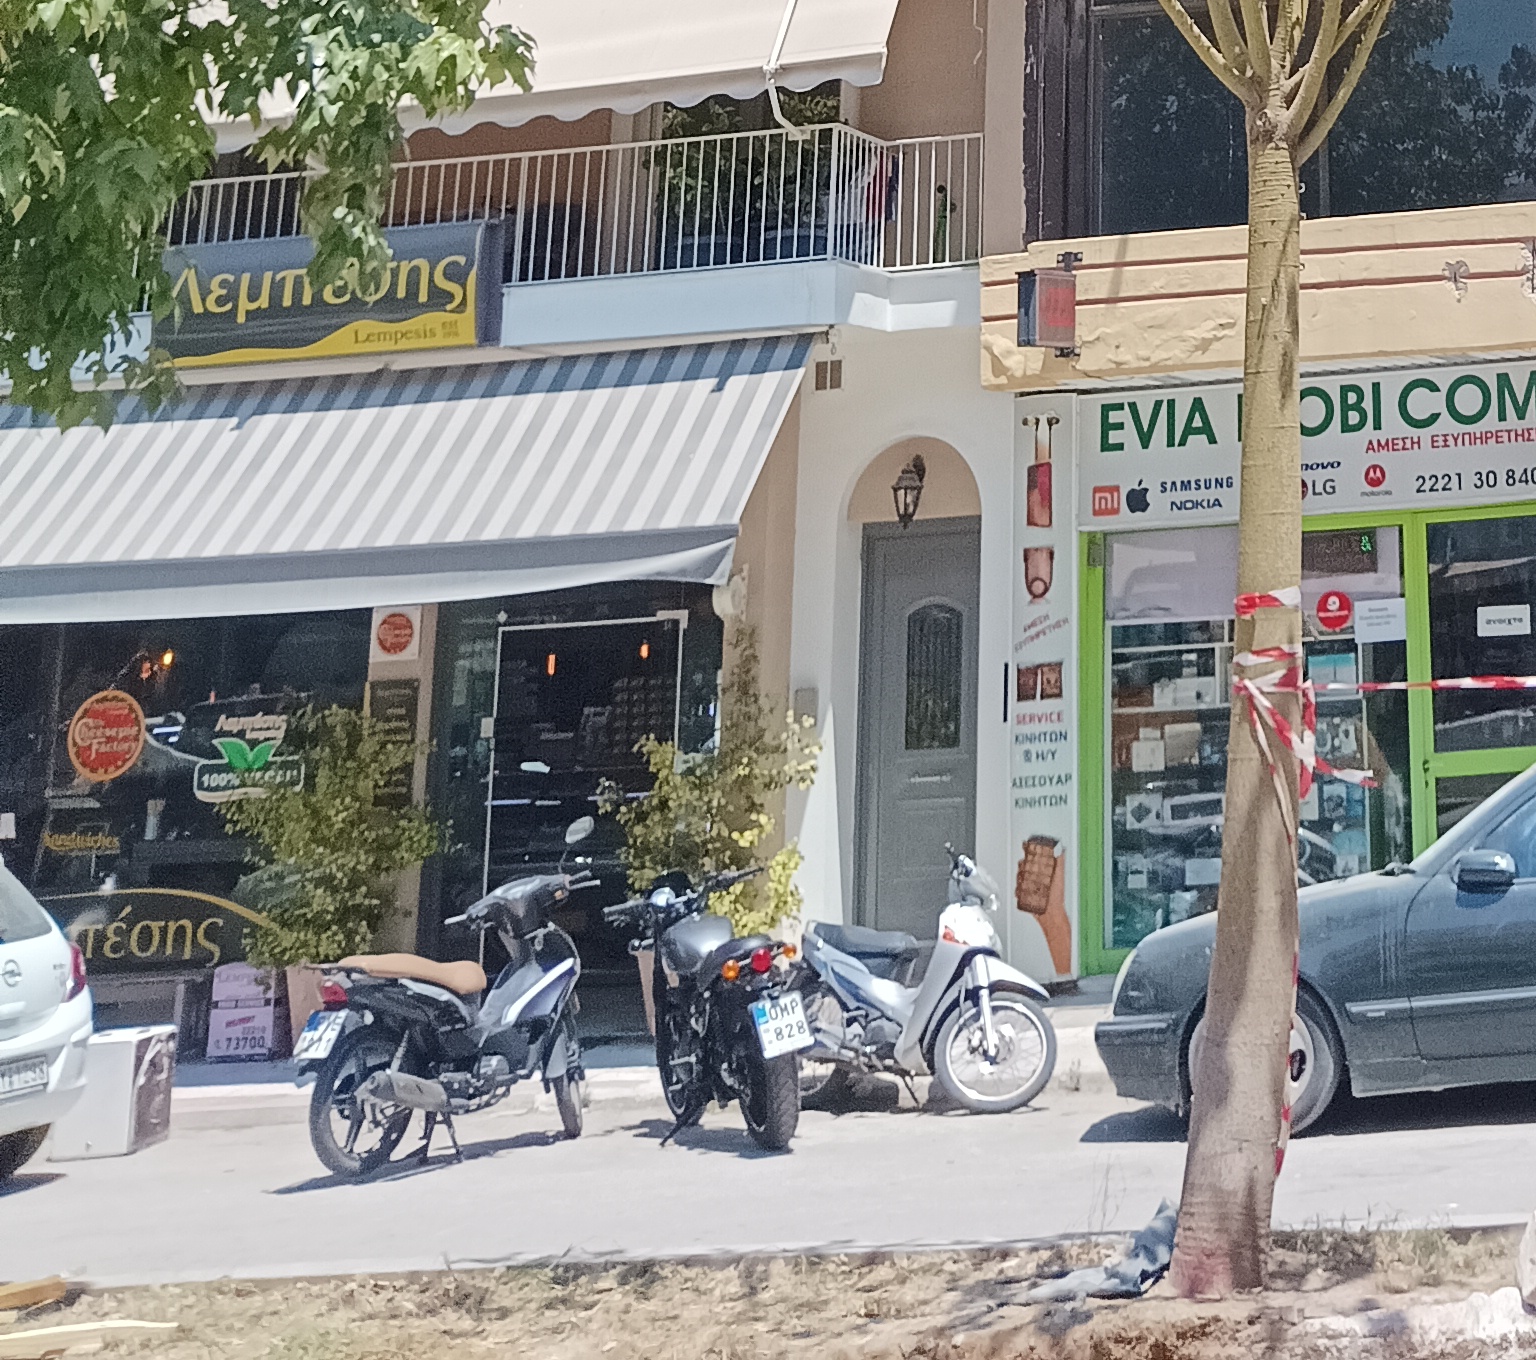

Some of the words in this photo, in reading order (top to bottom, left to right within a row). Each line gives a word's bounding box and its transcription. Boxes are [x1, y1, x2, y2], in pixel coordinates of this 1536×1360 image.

[354, 324, 437, 346] Lempesis
[1100, 396, 1218, 453] EVIA
[1237, 381, 1383, 443] OBI
[1365, 436, 1422, 454] ΑΜΕΣΗ
[1160, 476, 1234, 494] SAMSUNG
[1312, 478, 1337, 496] LG
[1415, 471, 1463, 494] 2221
[1473, 469, 1498, 490] 30
[1170, 497, 1223, 512] NOKIA
[1016, 710, 1064, 726] SERVICE
[1014, 731, 1068, 745] ΚΙΝΗΤΩΝ
[202, 772, 240, 788] 100%
[1014, 794, 1068, 808] ΚΙΝΗΤΩΝ
[70, 904, 224, 967] πέσης
[773, 1019, 807, 1042] 828
[225, 1035, 266, 1051] 73700
